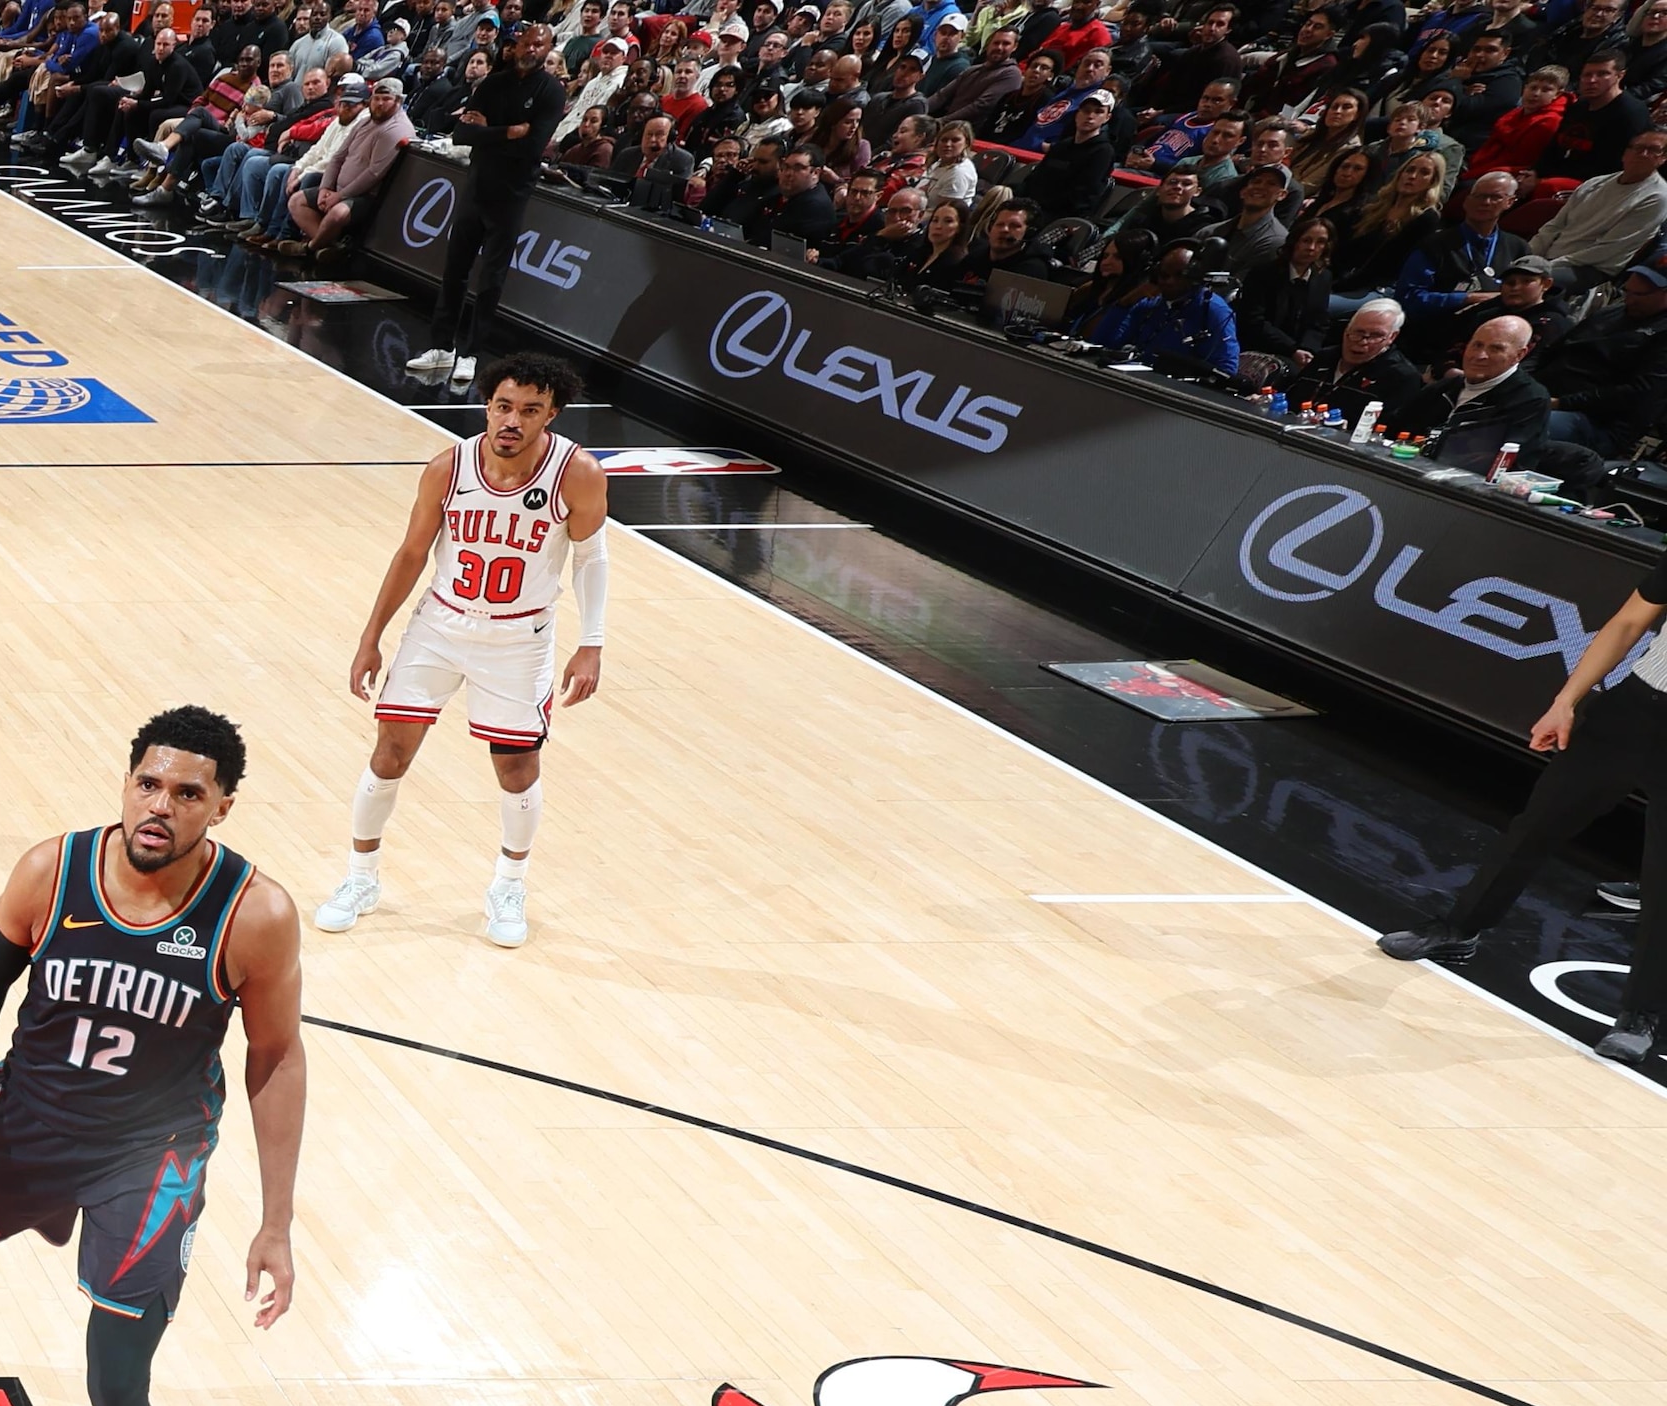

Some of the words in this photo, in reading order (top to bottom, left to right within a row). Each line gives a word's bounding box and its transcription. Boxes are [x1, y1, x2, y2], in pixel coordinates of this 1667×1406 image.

[782, 329, 1024, 454] LEXUS
[447, 510, 550, 553] BULLS
[453, 549, 526, 604] 30
[1374, 544, 1657, 691] LEX
[158, 943, 204, 958] StockX
[45, 958, 202, 1029] DETROIT
[67, 1016, 136, 1077] 12
